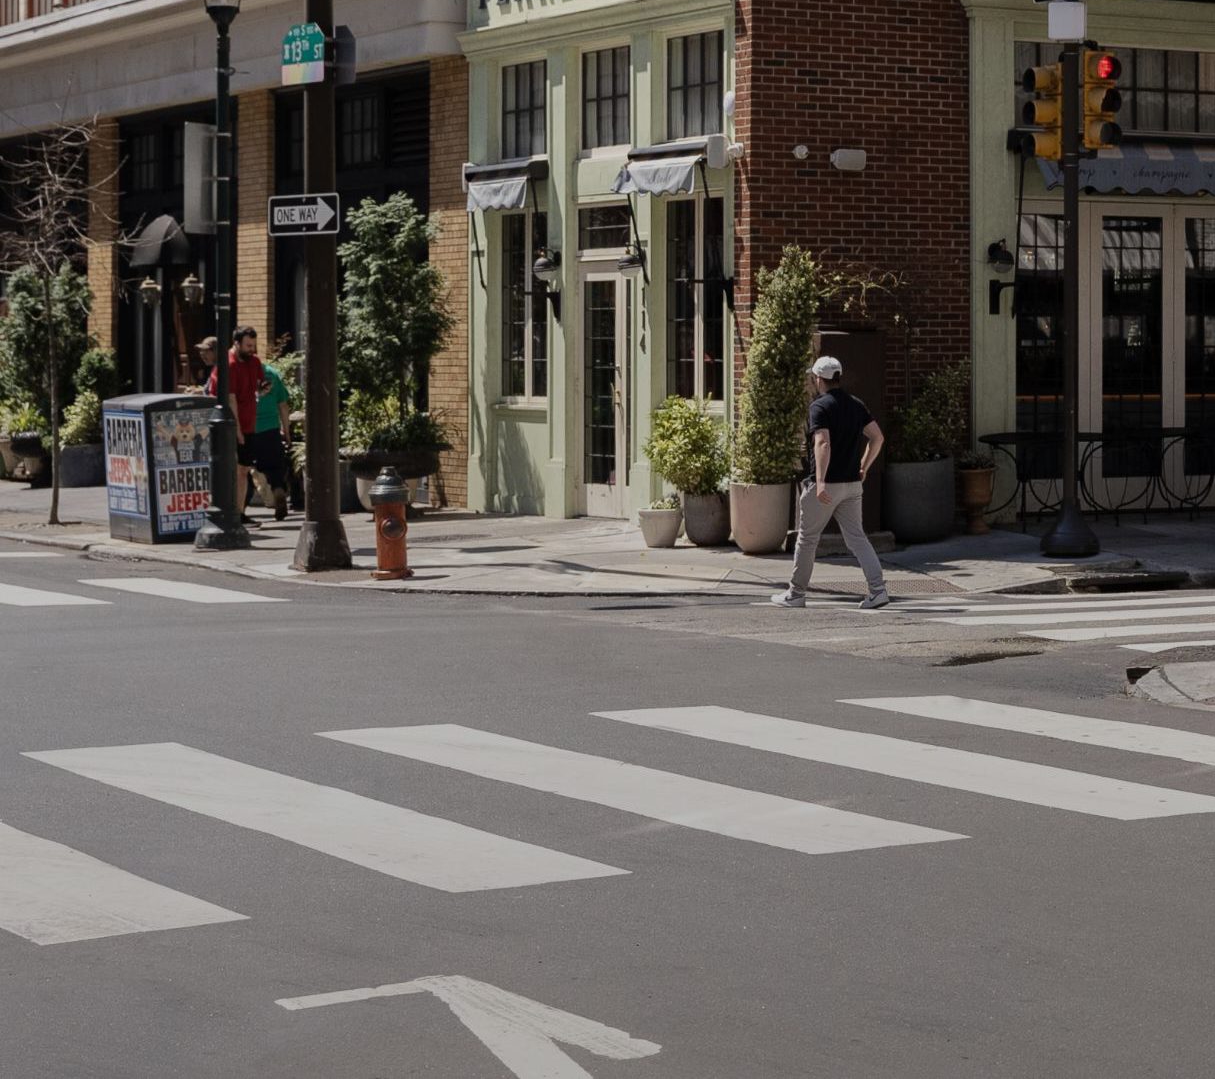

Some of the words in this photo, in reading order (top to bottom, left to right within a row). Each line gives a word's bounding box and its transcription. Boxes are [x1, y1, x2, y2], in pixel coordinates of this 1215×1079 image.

[313, 43, 324, 59] ST
[276, 208, 296, 223] ONE
[299, 207, 319, 221] WAY
[159, 466, 210, 494] BARBER
[167, 492, 210, 513] JEEPS
